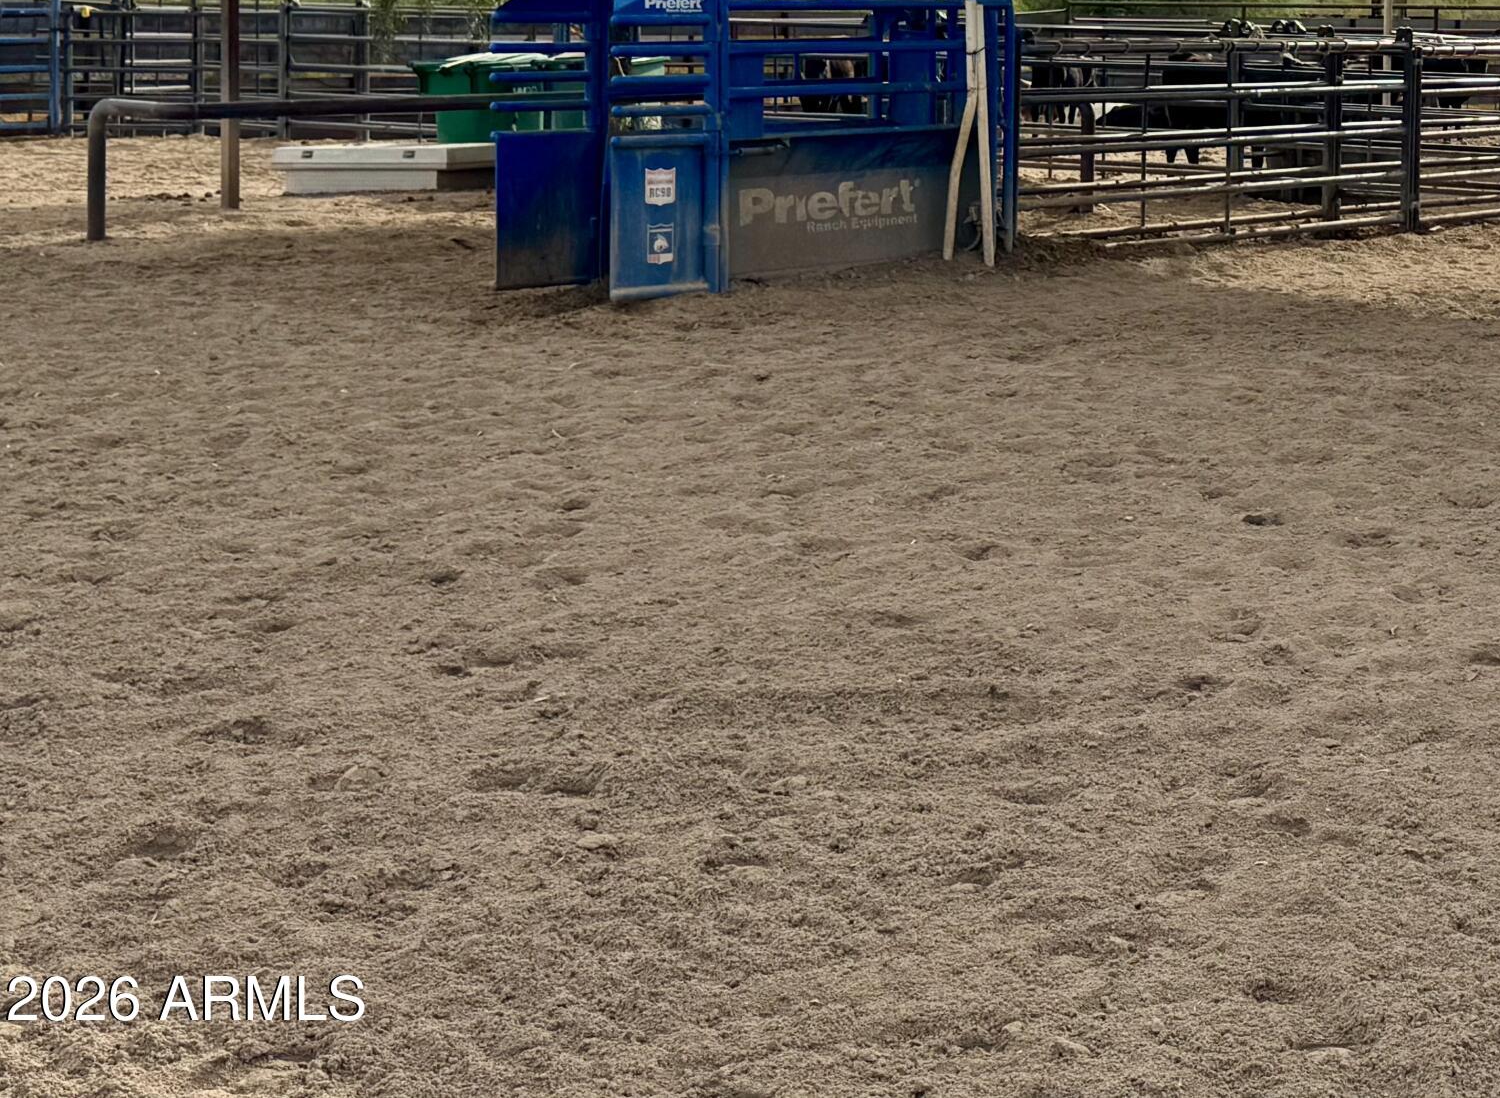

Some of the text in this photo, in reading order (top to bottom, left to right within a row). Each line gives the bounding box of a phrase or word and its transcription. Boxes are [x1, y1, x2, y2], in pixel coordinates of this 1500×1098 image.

[739, 178, 917, 227] Priefert
[806, 213, 919, 232] Ranch Equipment
